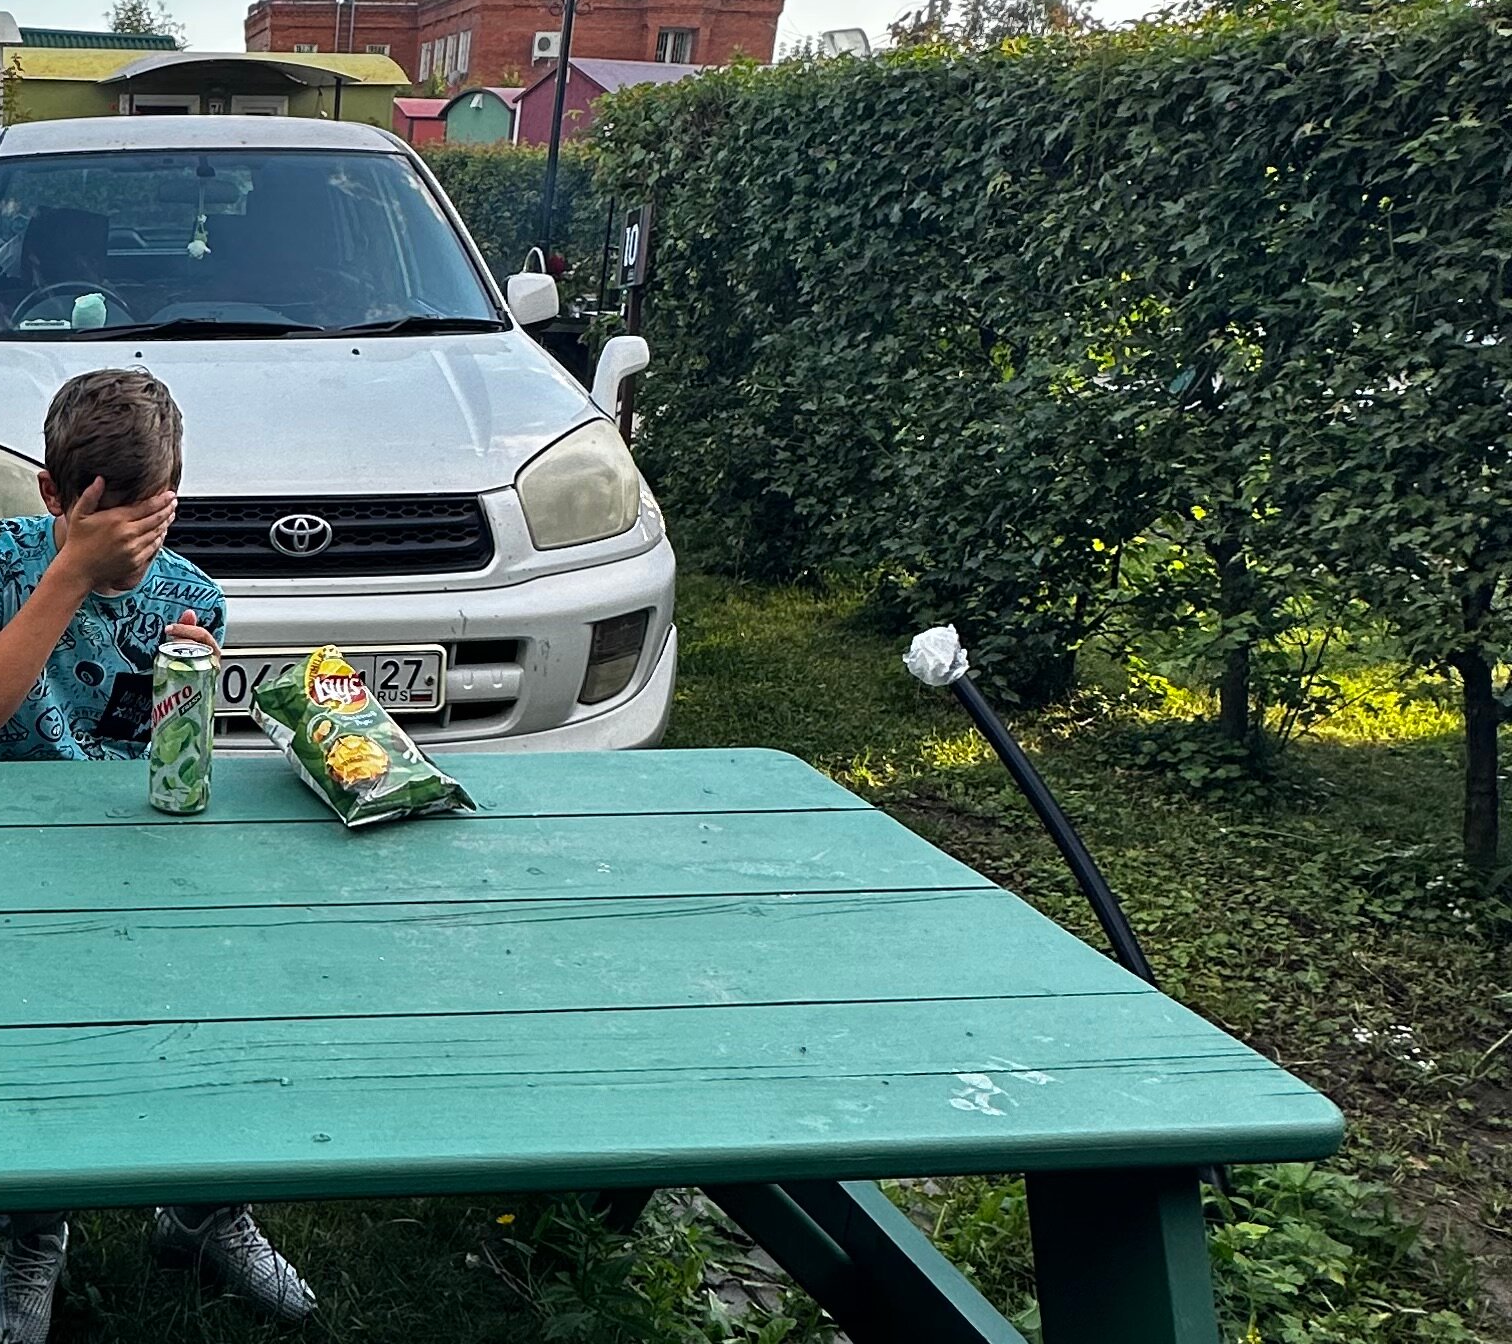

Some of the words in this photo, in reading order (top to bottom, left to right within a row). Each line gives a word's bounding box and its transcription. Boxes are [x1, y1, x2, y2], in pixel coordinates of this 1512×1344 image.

[624, 223, 639, 266] 10
[379, 659, 423, 689] 27
[152, 686, 193, 730] ОХИТО
[377, 690, 408, 702] RUS
